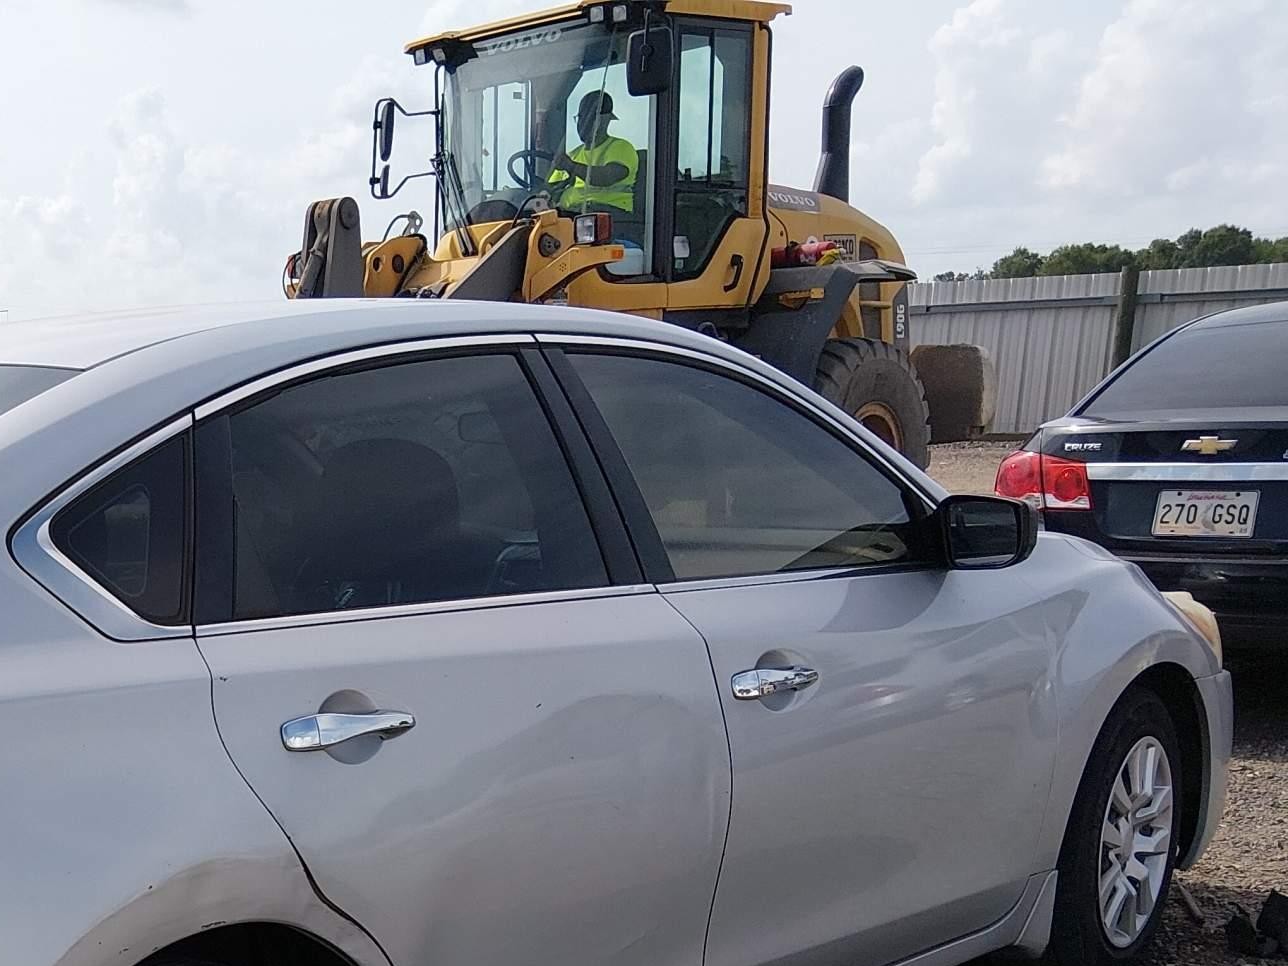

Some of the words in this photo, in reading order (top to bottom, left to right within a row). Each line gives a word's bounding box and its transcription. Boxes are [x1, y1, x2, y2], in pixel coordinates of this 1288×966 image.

[488, 30, 562, 56] VOLVO
[768, 192, 816, 207] VOLVO
[896, 304, 905, 339] L90G
[1064, 443, 1102, 452] CRUZE
[1159, 503, 1198, 525] 270
[1211, 503, 1250, 525] GSQ
